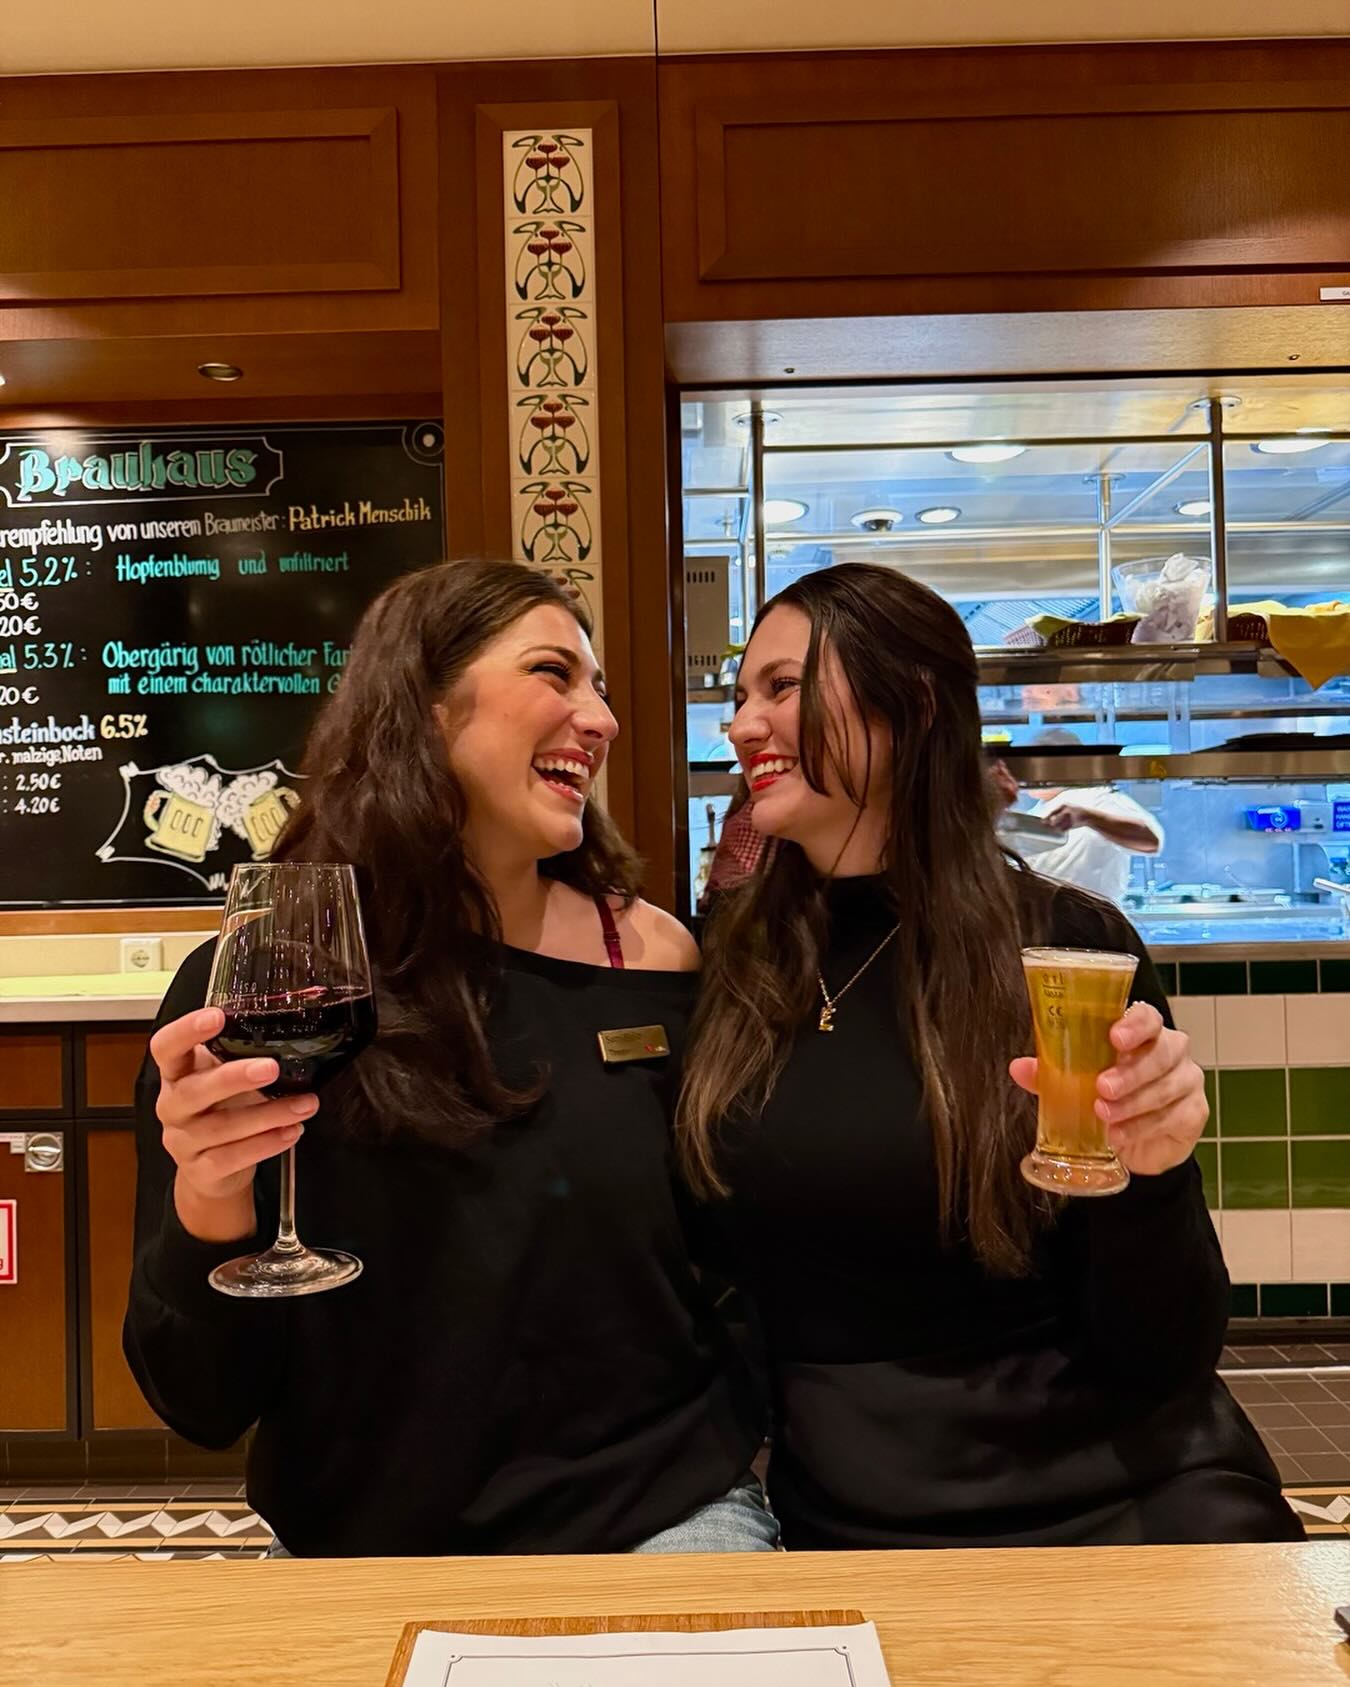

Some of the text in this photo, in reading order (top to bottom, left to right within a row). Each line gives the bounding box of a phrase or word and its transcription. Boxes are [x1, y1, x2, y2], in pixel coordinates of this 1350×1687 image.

[15, 440, 258, 501] Brauhaus
[106, 522, 138, 542] von
[140, 518, 201, 540] unserem
[288, 502, 355, 531] Patrick
[359, 497, 431, 525] Menschik
[115, 553, 220, 585] Hopfenblumig
[238, 550, 267, 575] und
[279, 551, 350, 573] unfiltriert
[102, 640, 199, 675] Obergärig
[206, 645, 236, 666] von
[241, 639, 318, 667] rötlicher
[107, 672, 131, 694] mit
[137, 674, 188, 695] einem
[191, 671, 320, 695] charaktervollen
[0, 714, 149, 744] steinbock 6.5%
[15, 773, 62, 791] 2.50€
[14, 796, 61, 815] 4.20€
